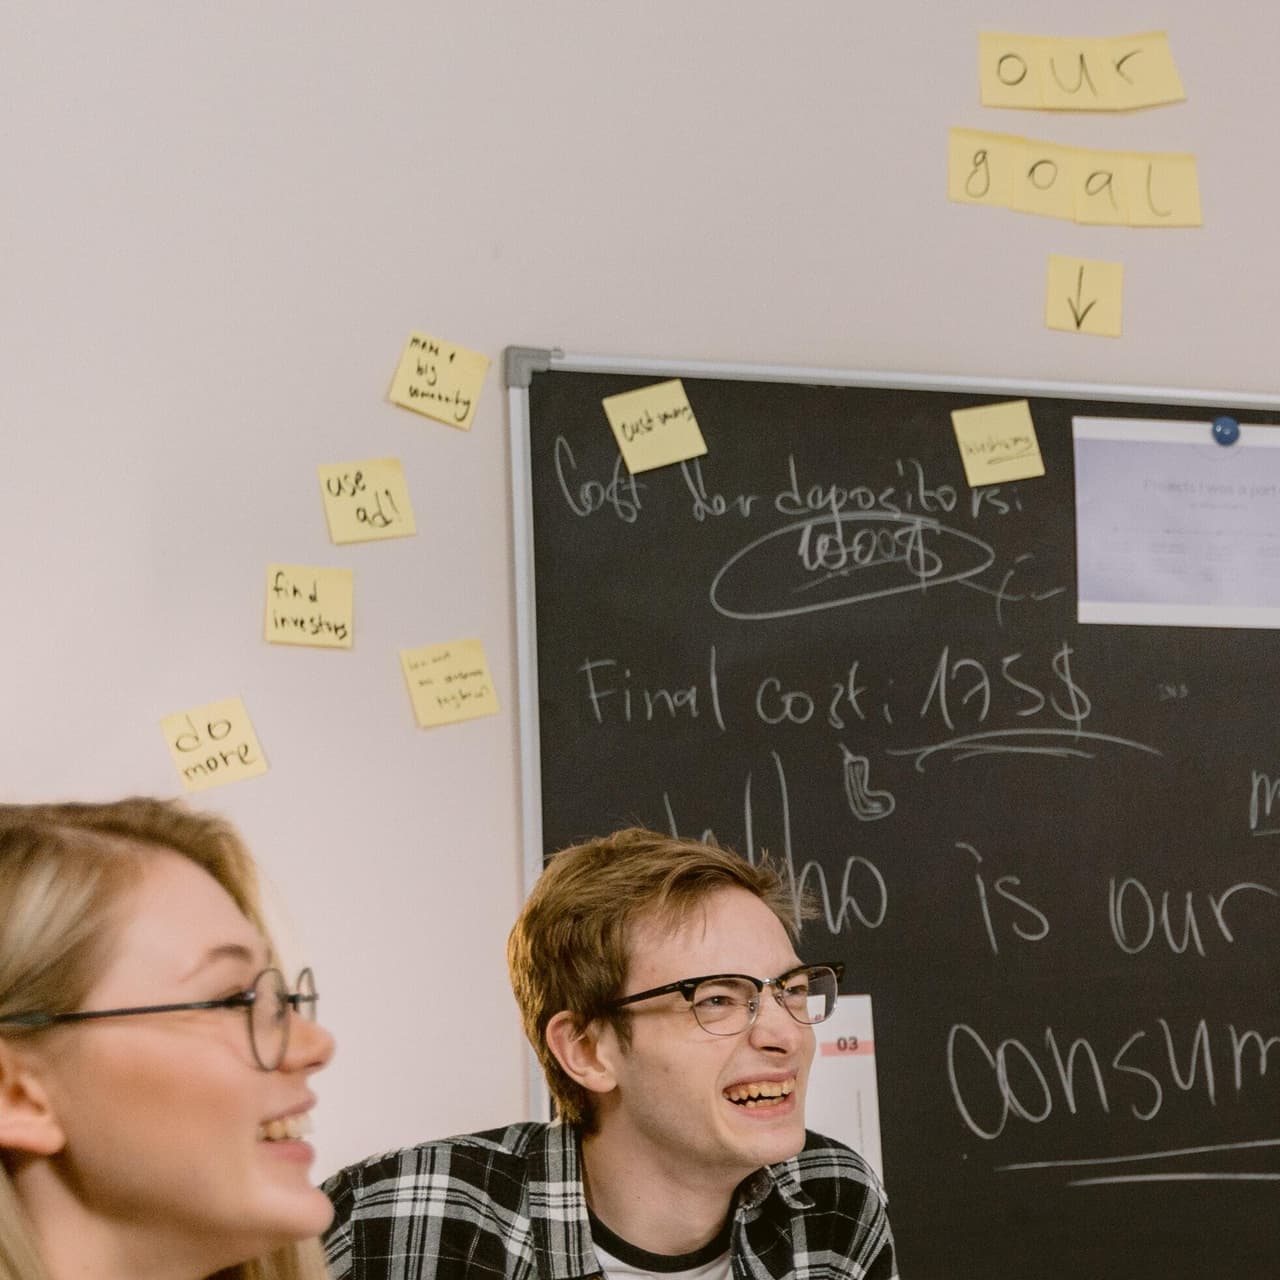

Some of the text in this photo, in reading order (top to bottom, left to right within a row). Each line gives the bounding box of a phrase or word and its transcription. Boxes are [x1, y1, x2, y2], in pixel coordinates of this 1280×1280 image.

[996, 48, 1144, 97] our
[964, 149, 1173, 217] goal
[326, 469, 367, 497] use
[272, 570, 320, 603] find
[578, 645, 727, 732] Final
[920, 641, 1093, 740] 175$
[174, 713, 232, 753] do
[184, 743, 258, 781] more
[954, 842, 1051, 955] is
[836, 1035, 859, 1052] 03
